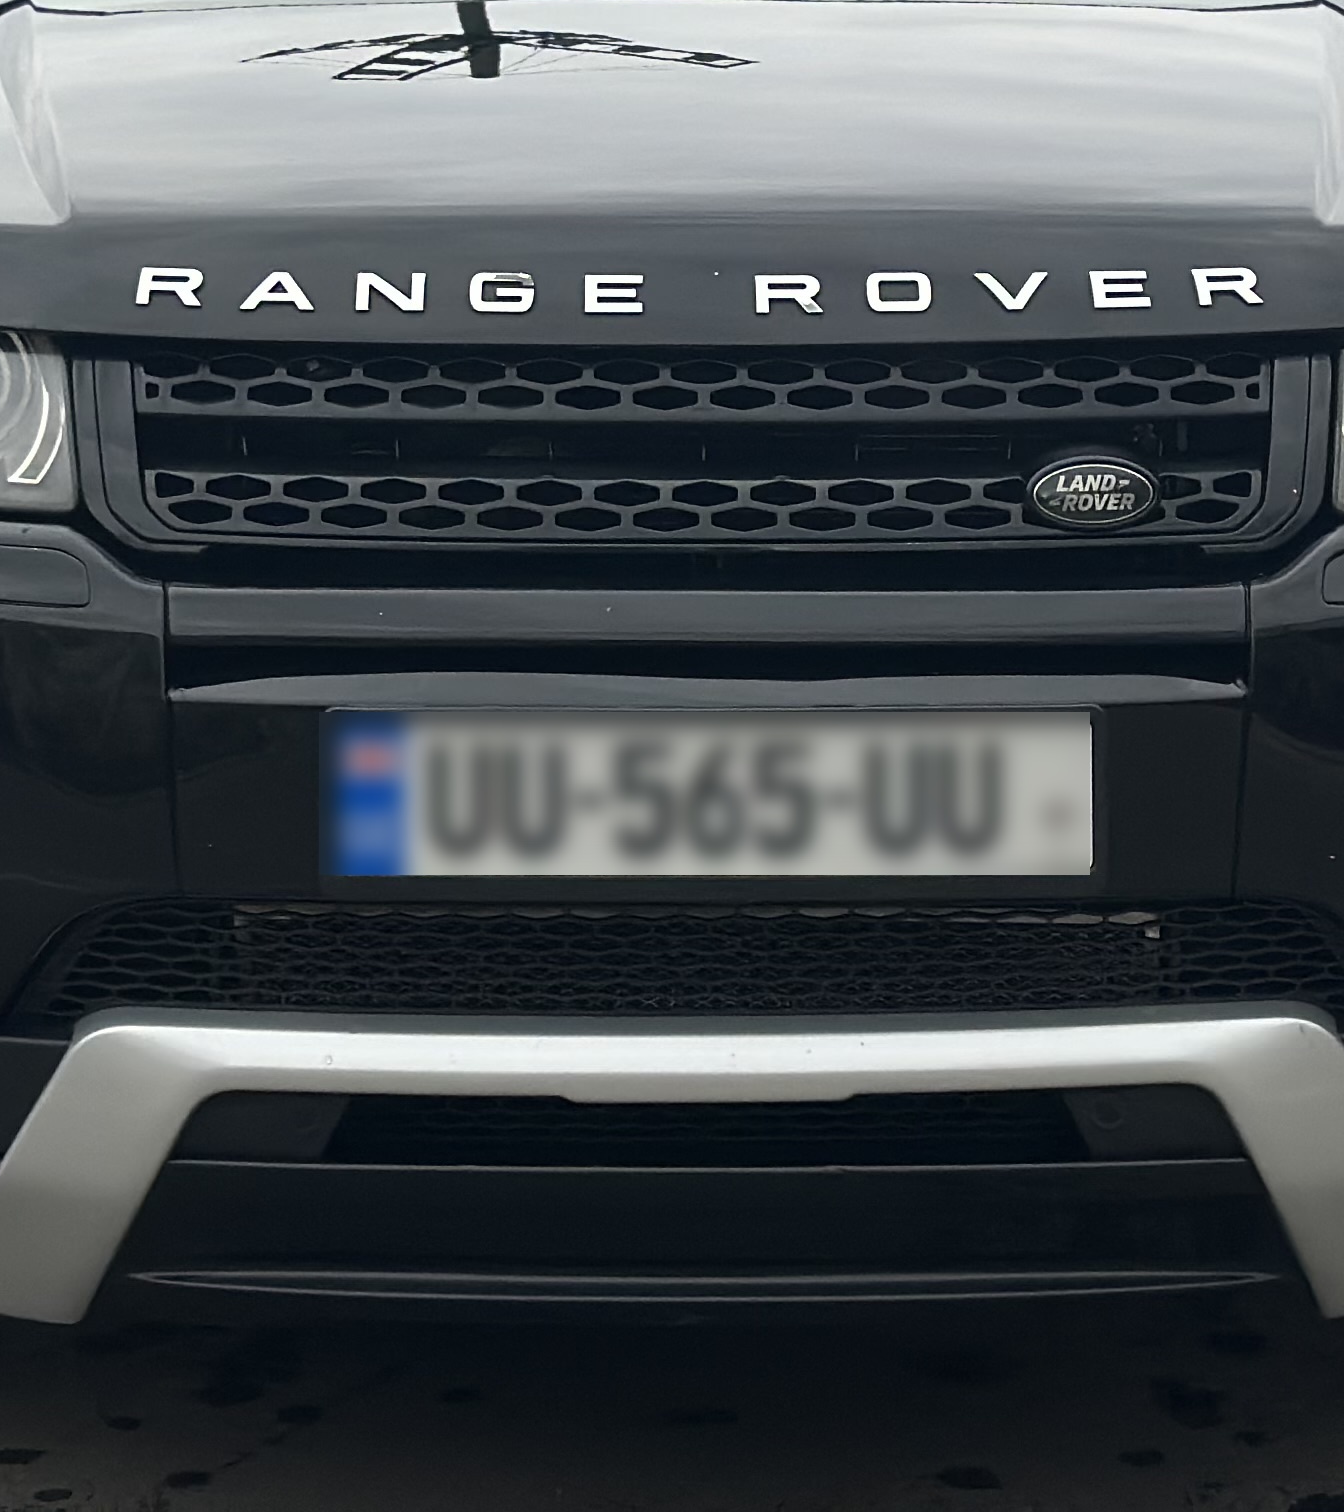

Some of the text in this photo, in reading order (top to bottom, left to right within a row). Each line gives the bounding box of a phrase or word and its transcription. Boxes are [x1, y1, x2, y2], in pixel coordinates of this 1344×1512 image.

[135, 266, 1264, 314] RANGE ROVER
[1056, 474, 1117, 493] LAND
[1061, 492, 1136, 512] ROVER
